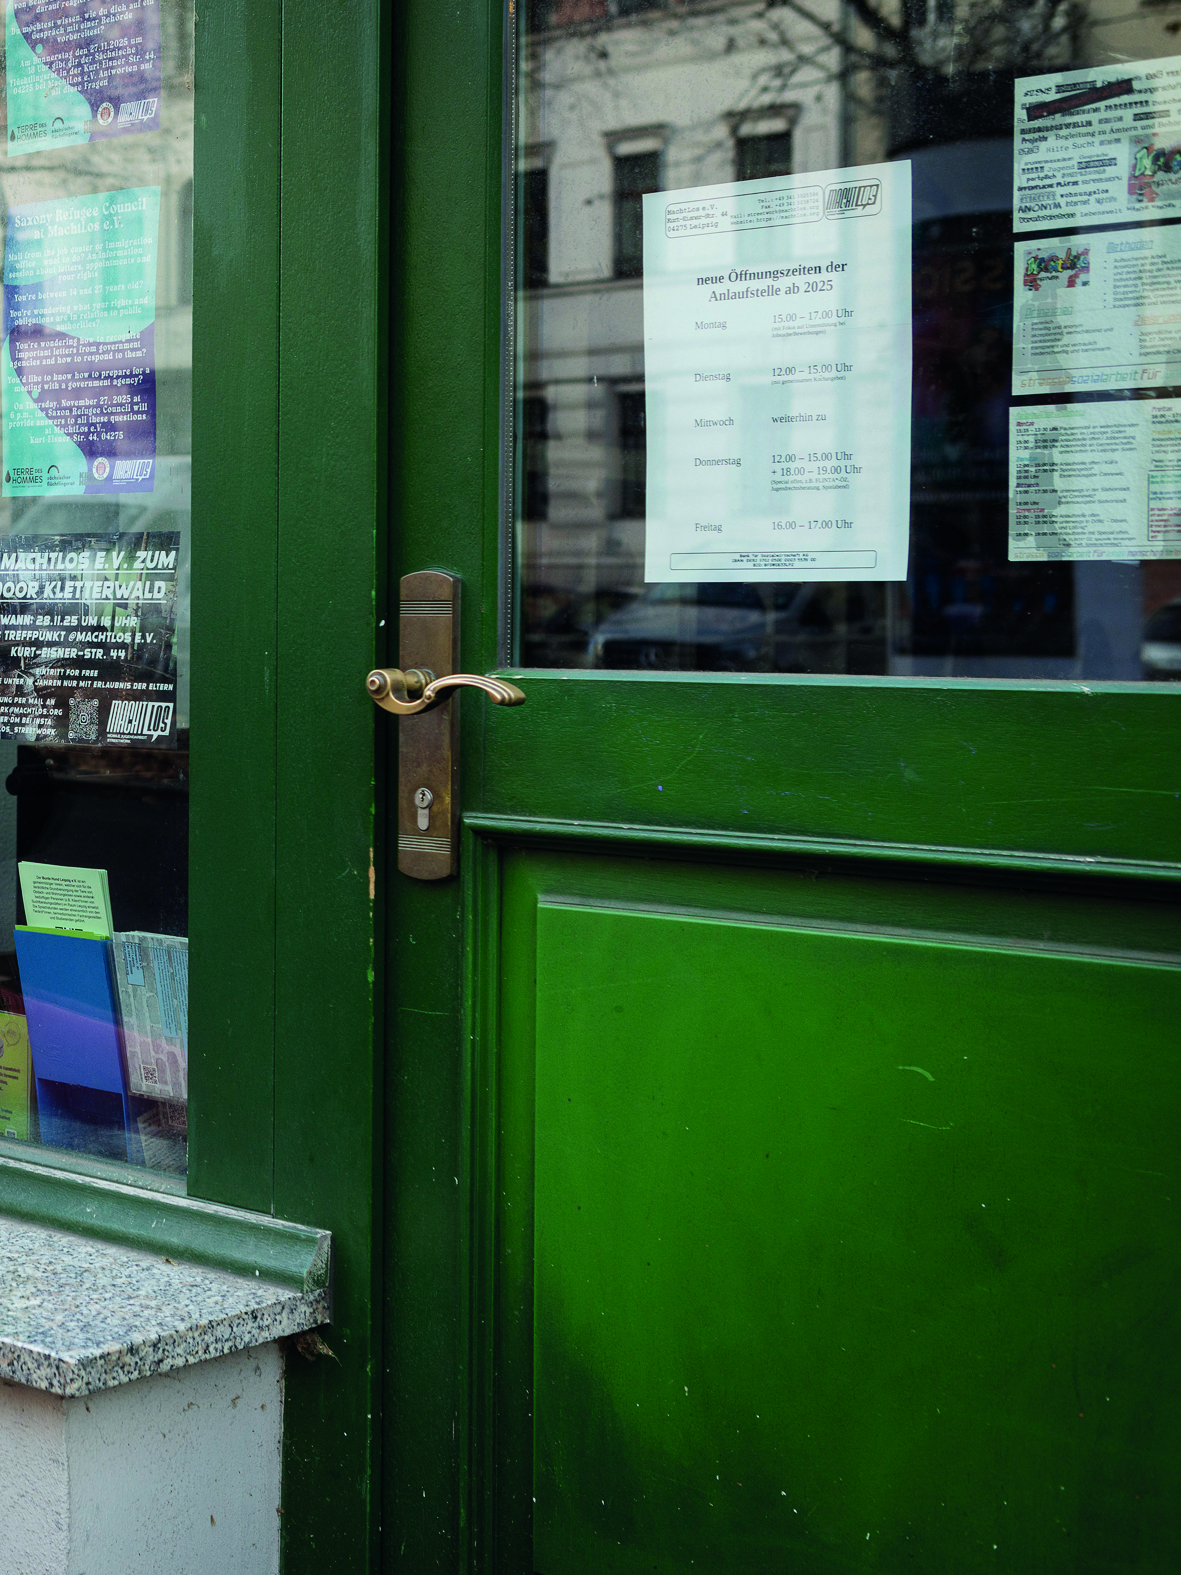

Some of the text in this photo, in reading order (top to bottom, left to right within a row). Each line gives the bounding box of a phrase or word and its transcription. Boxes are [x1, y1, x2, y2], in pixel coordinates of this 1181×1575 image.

[1055, 128, 1096, 140] Begleitung
[1109, 125, 1138, 135] Ämtern
[1140, 123, 1155, 131] und
[15, 198, 146, 227] Saxony Refugee Council
[1018, 202, 1062, 214] ANONYM
[1080, 208, 1123, 217] Lebenswelt
[35, 216, 123, 239] at MachtLos e.V.
[697, 261, 847, 285] neue Öffnungszeiten der
[709, 279, 833, 302] Anlaufstelle ab 2025
[773, 313, 797, 324] 15.00
[808, 310, 833, 321] 17.00
[836, 308, 854, 318] Uhr
[695, 321, 727, 330] Montag
[772, 366, 796, 377] 12.00
[808, 364, 832, 374] 15.00
[835, 362, 853, 373] Uhr
[694, 373, 731, 382] Dienstag
[14, 402, 23, 410] On
[26, 400, 59, 409] Thursday,
[61, 398, 97, 407] November
[100, 397, 110, 405] 27,
[113, 395, 131, 403] 2025
[694, 417, 734, 427] Mittwoch
[771, 413, 813, 423] weiterhin
[89, 433, 99, 441] 44,
[102, 432, 124, 440] 04275
[694, 458, 742, 467] Donnerstag
[772, 453, 796, 463] 12.00
[808, 452, 833, 462] 15.00
[835, 451, 853, 461] Uhr
[781, 466, 806, 477] 18.00
[817, 465, 842, 475] 19.00
[844, 464, 863, 474] Uhr
[12, 476, 43, 484] HOMMES
[695, 523, 723, 533] Freitag
[772, 520, 797, 530] 16.00
[808, 520, 833, 529] 17.00
[835, 519, 853, 529] Uhr
[1, 552, 90, 569] MACHTLOS
[94, 551, 127, 569] E.V.
[133, 550, 176, 569] ZUM
[44, 581, 166, 598] KLETTERWALD
[0, 615, 137, 626] WANN: 28.11.25 UM 16 UHR
[4, 631, 66, 641] TREFFPUNKT
[68, 632, 131, 642] @MACHTLOS
[135, 633, 156, 643] E.V.
[11, 647, 126, 659] KURT-EISNER-STR. 44
[35, 678, 62, 686] JAHREN
[93, 681, 131, 689] ERLAUBNIS
[133, 682, 147, 690] DER
[149, 683, 173, 691] ELTERN
